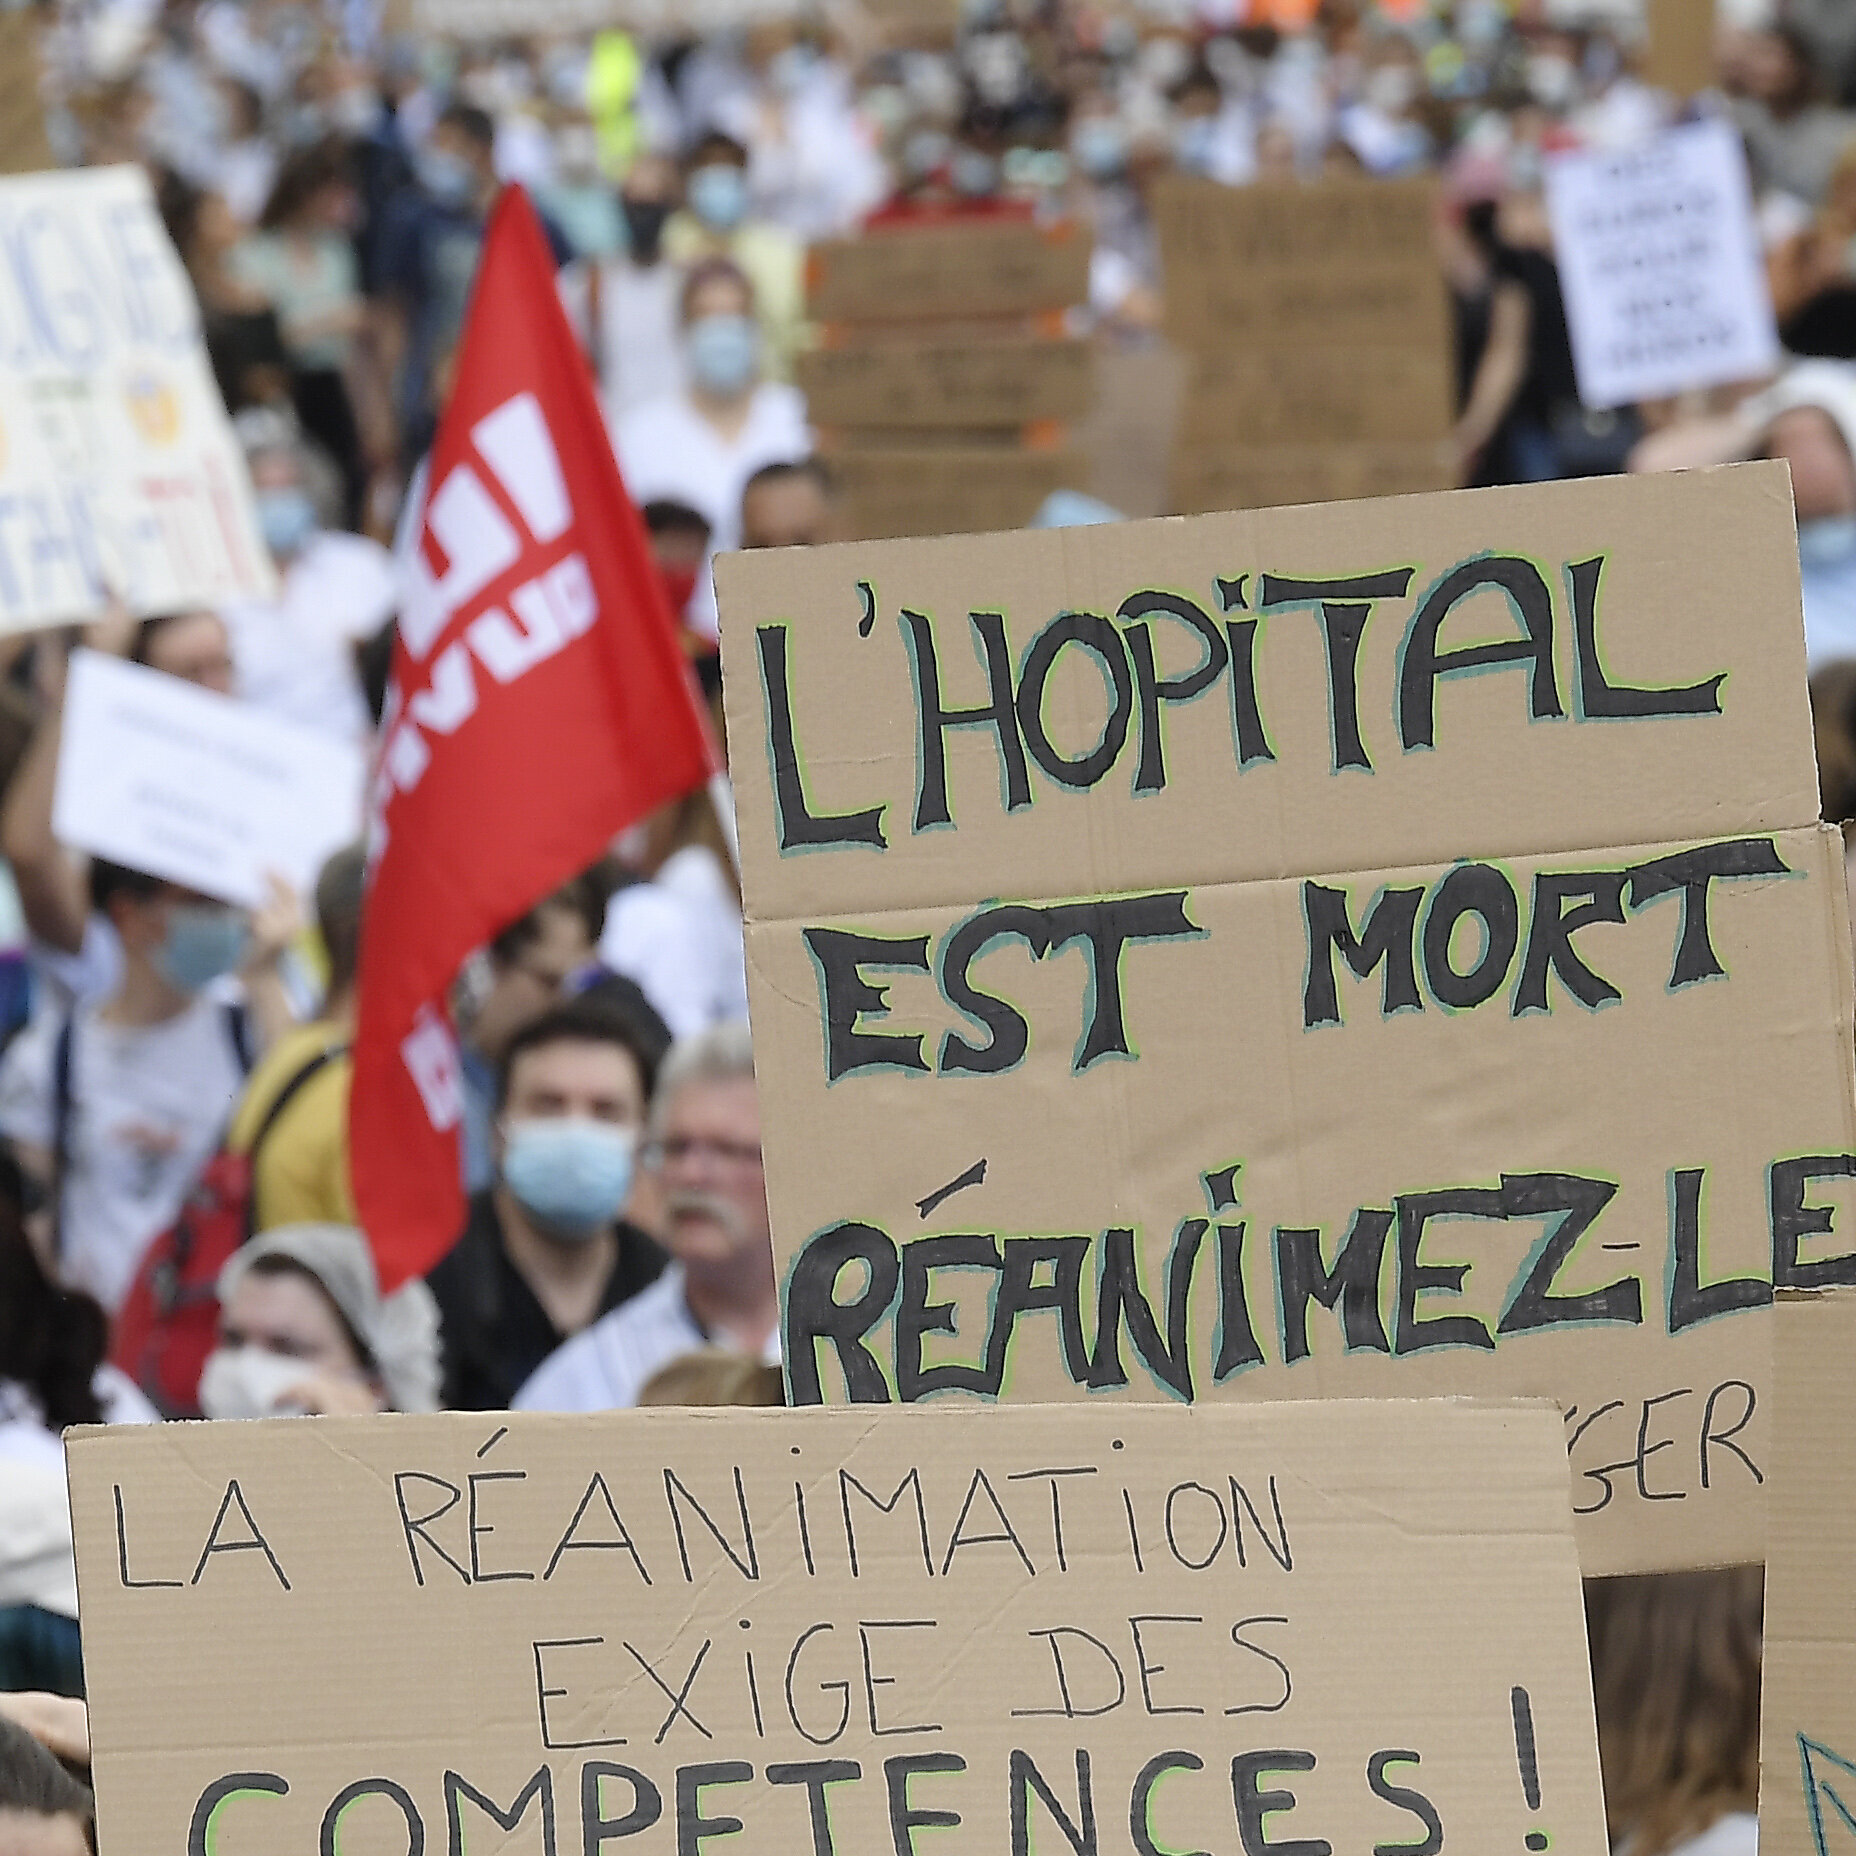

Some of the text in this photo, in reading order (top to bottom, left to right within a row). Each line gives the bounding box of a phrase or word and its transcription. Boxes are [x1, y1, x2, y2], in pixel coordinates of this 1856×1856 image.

[800, 836, 1804, 1088] EST MORT
[1568, 1380, 1765, 1515] GER
[111, 1477, 292, 1592] LA
[1008, 1613, 1294, 1720] DES
